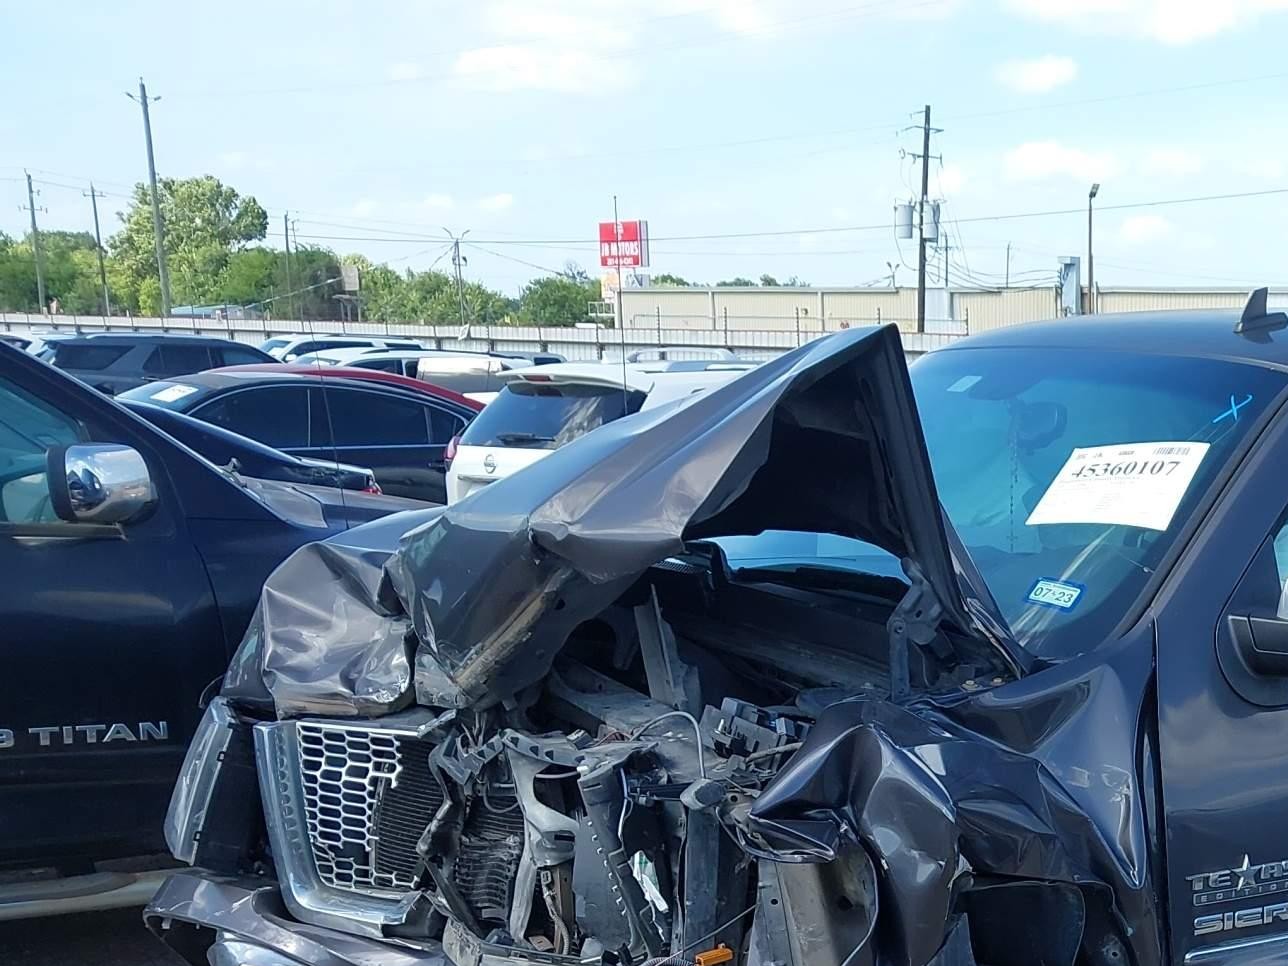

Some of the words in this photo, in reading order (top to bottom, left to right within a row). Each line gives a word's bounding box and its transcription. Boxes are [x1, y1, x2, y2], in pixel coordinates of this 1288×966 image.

[1071, 460, 1181, 478] 45360107
[1033, 586, 1052, 598] 07
[1054, 591, 1074, 603] 23
[28, 721, 169, 746] TITAN
